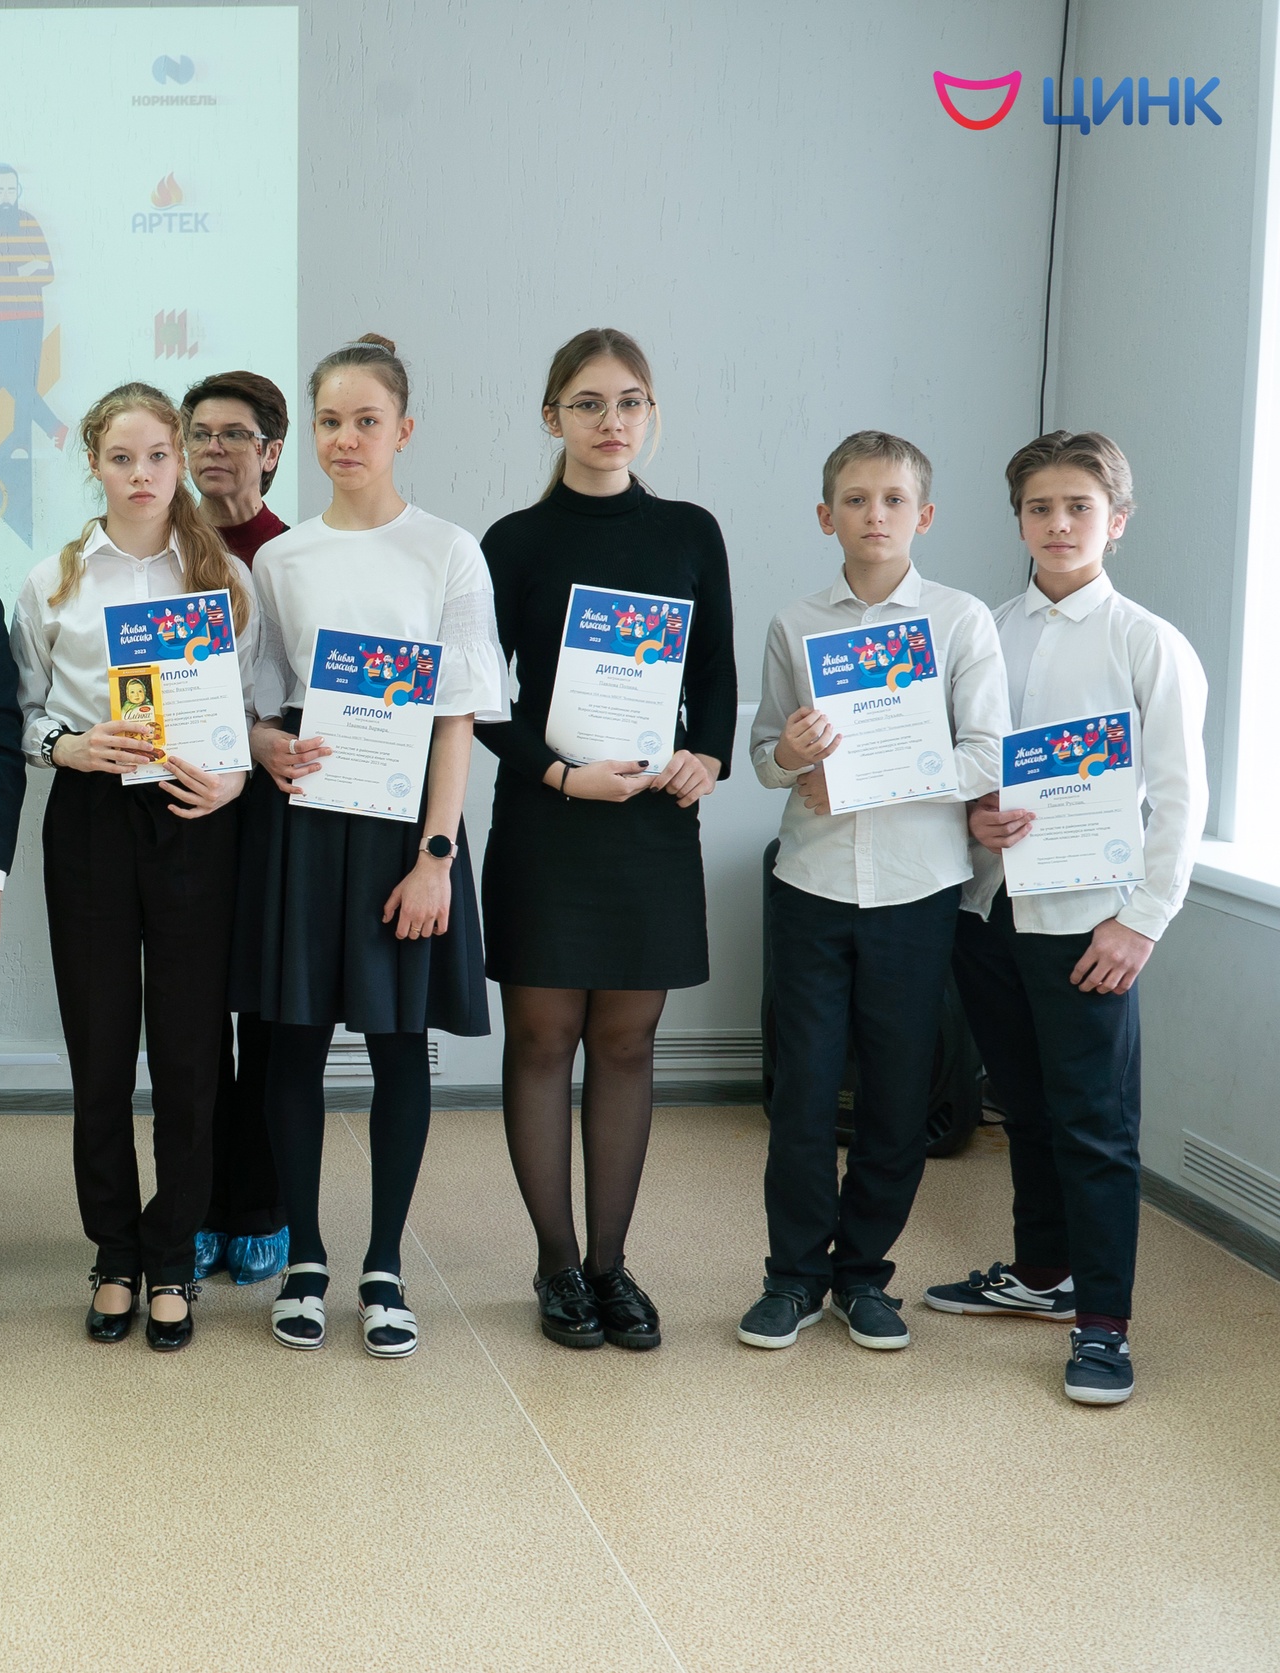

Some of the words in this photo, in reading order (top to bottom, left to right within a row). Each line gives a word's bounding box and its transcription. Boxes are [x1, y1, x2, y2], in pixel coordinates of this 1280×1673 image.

[131, 95, 218, 106] НОРНИКЕЛЬ
[131, 212, 210, 234] АРТЕК
[582, 608, 608, 621] Живая
[120, 622, 147, 634] Живая
[580, 620, 611, 632] классика
[120, 632, 152, 645] классика
[327, 648, 355, 662] Живая
[822, 653, 848, 666] Живая
[326, 661, 358, 673] классика
[596, 664, 643, 678] ДИПЛОМ
[822, 662, 854, 676] классика
[160, 668, 198, 680] ИПЛОМ
[853, 696, 902, 714] ДИПЛОМ
[342, 705, 392, 720] ДИПЛОМ
[1015, 746, 1043, 759] Живая
[1014, 754, 1048, 768] классика
[1040, 783, 1092, 799] ДИПЛОМ
